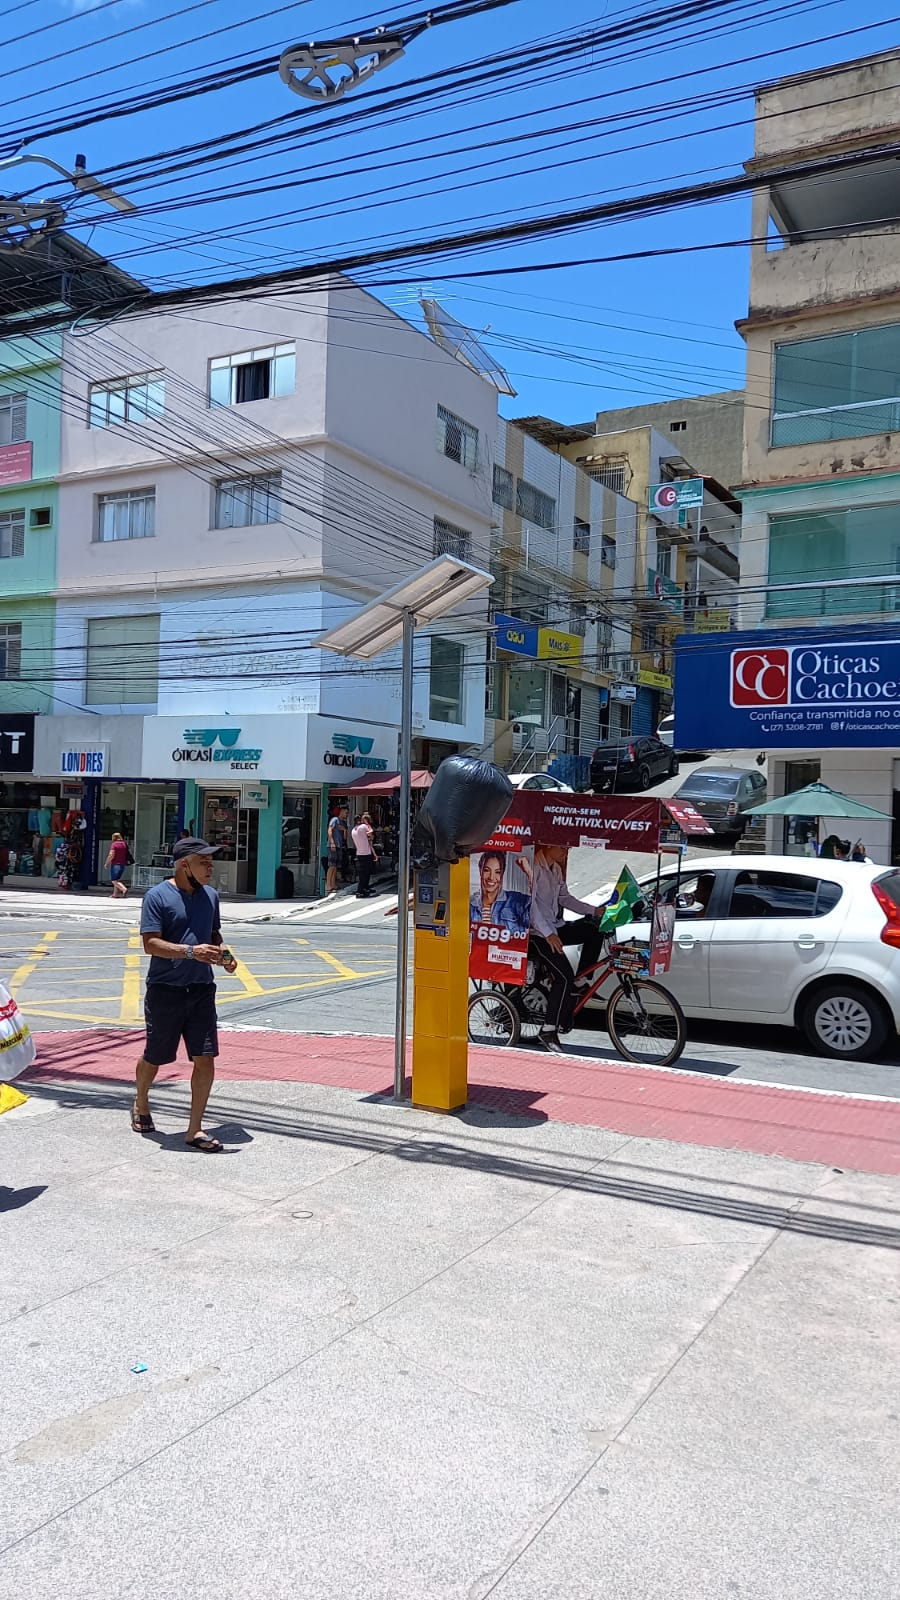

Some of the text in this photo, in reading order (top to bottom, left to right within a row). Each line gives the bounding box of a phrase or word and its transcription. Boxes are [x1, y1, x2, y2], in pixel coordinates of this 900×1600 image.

[750, 710, 803, 722] Confiança
[806, 709, 872, 720] transmitida
[875, 710, 890, 718] no
[62, 752, 103, 772] LONDRES
[172, 748, 263, 762] ÓTICAS EXPRESS
[544, 805, 600, 816] INSCREVA-SE EM
[552, 815, 652, 832] MULTIVIX.VC/VEST
